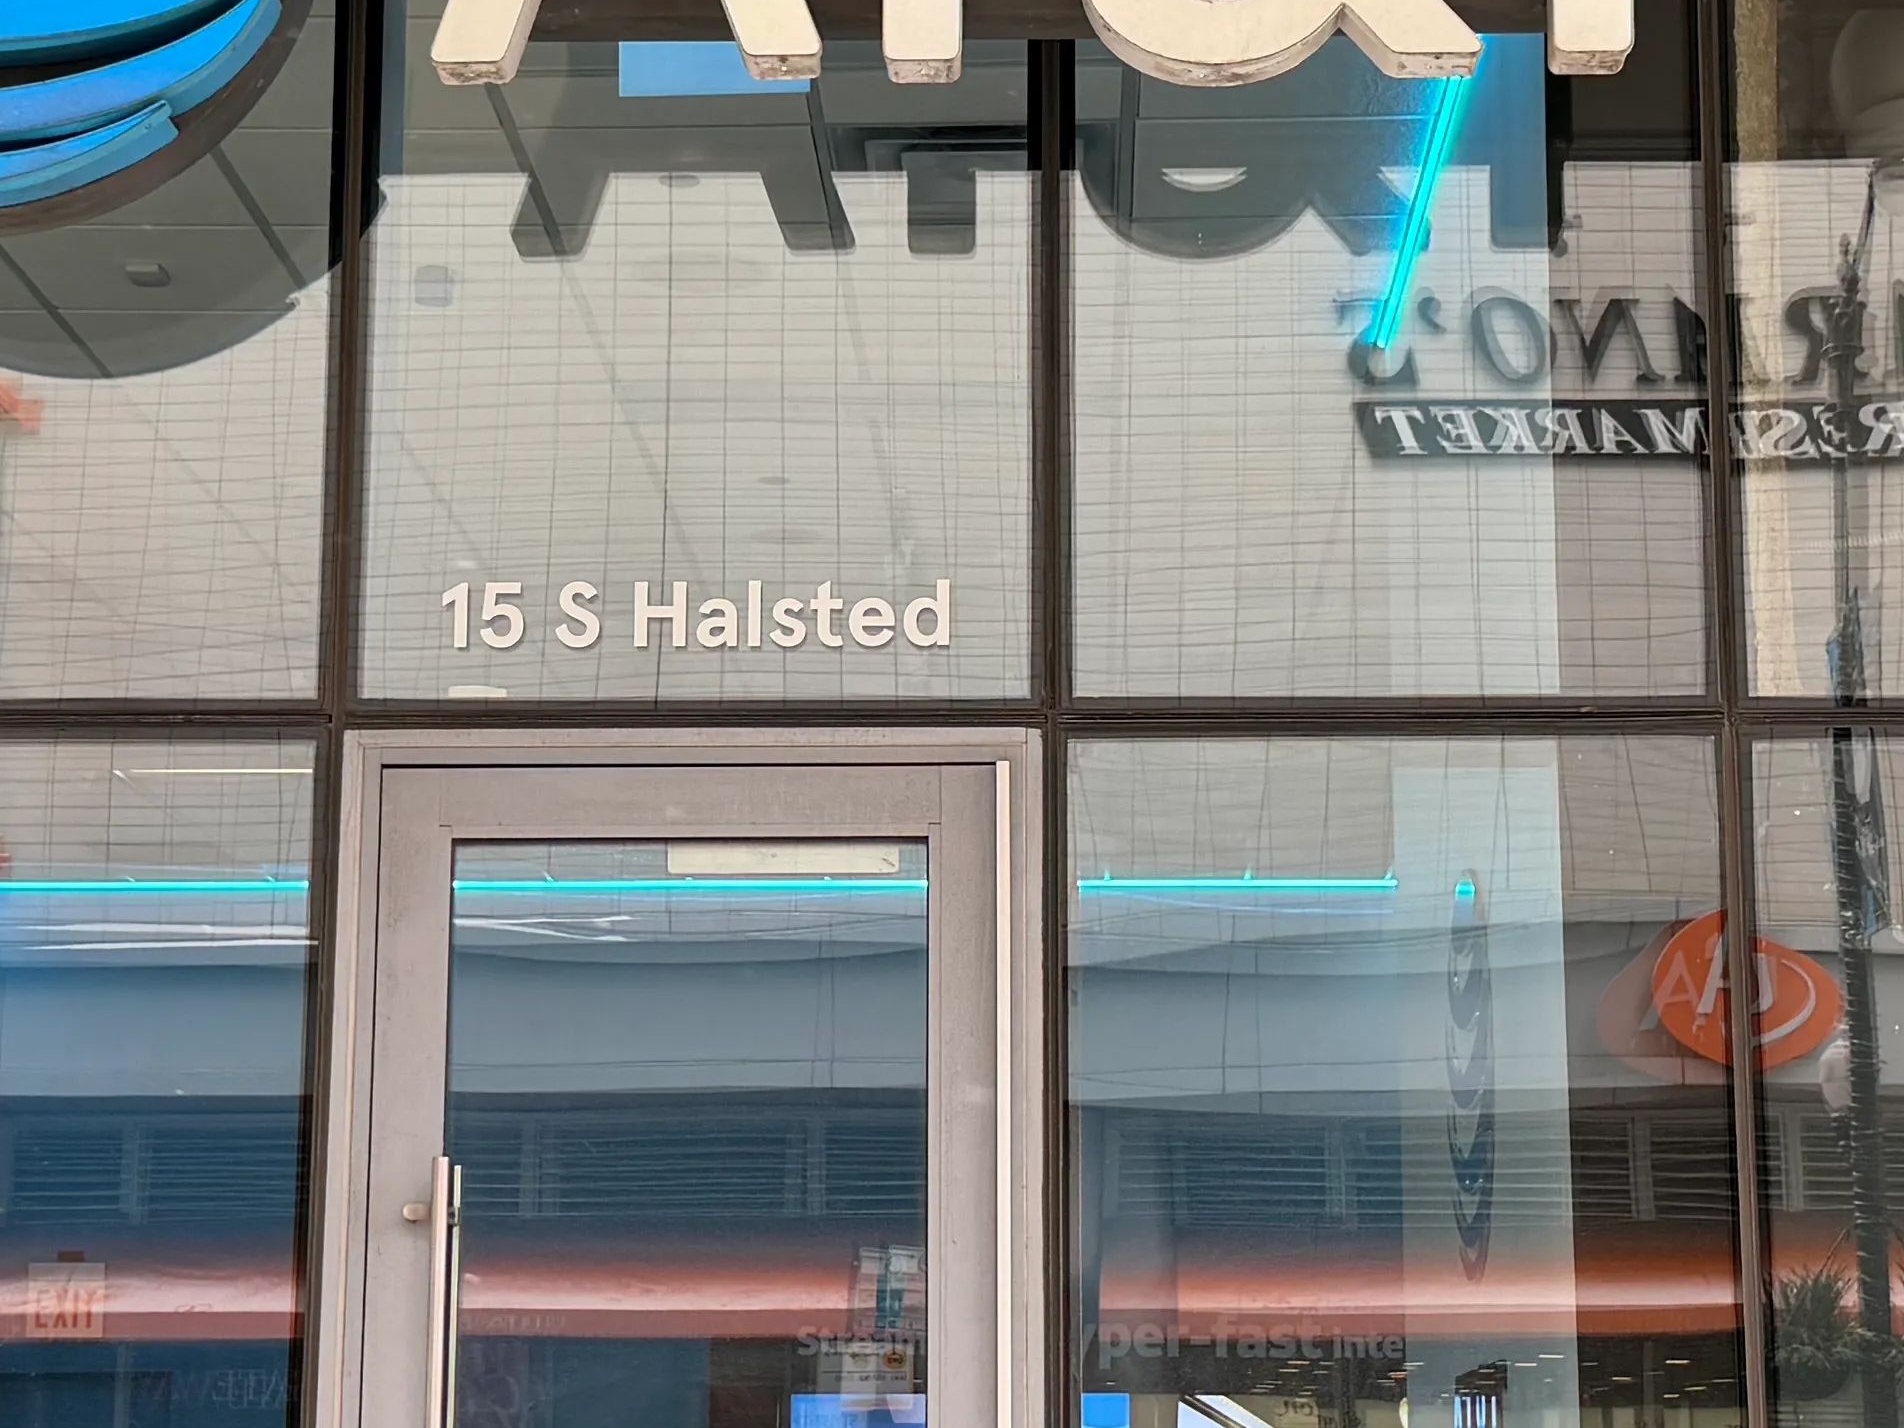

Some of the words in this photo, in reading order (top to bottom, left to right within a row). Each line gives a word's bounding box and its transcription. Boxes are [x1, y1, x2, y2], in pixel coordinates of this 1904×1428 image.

[441, 581, 526, 650] 15
[554, 580, 601, 649] S
[633, 578, 952, 649] Halsted
[35, 1288, 96, 1330] EXIT
